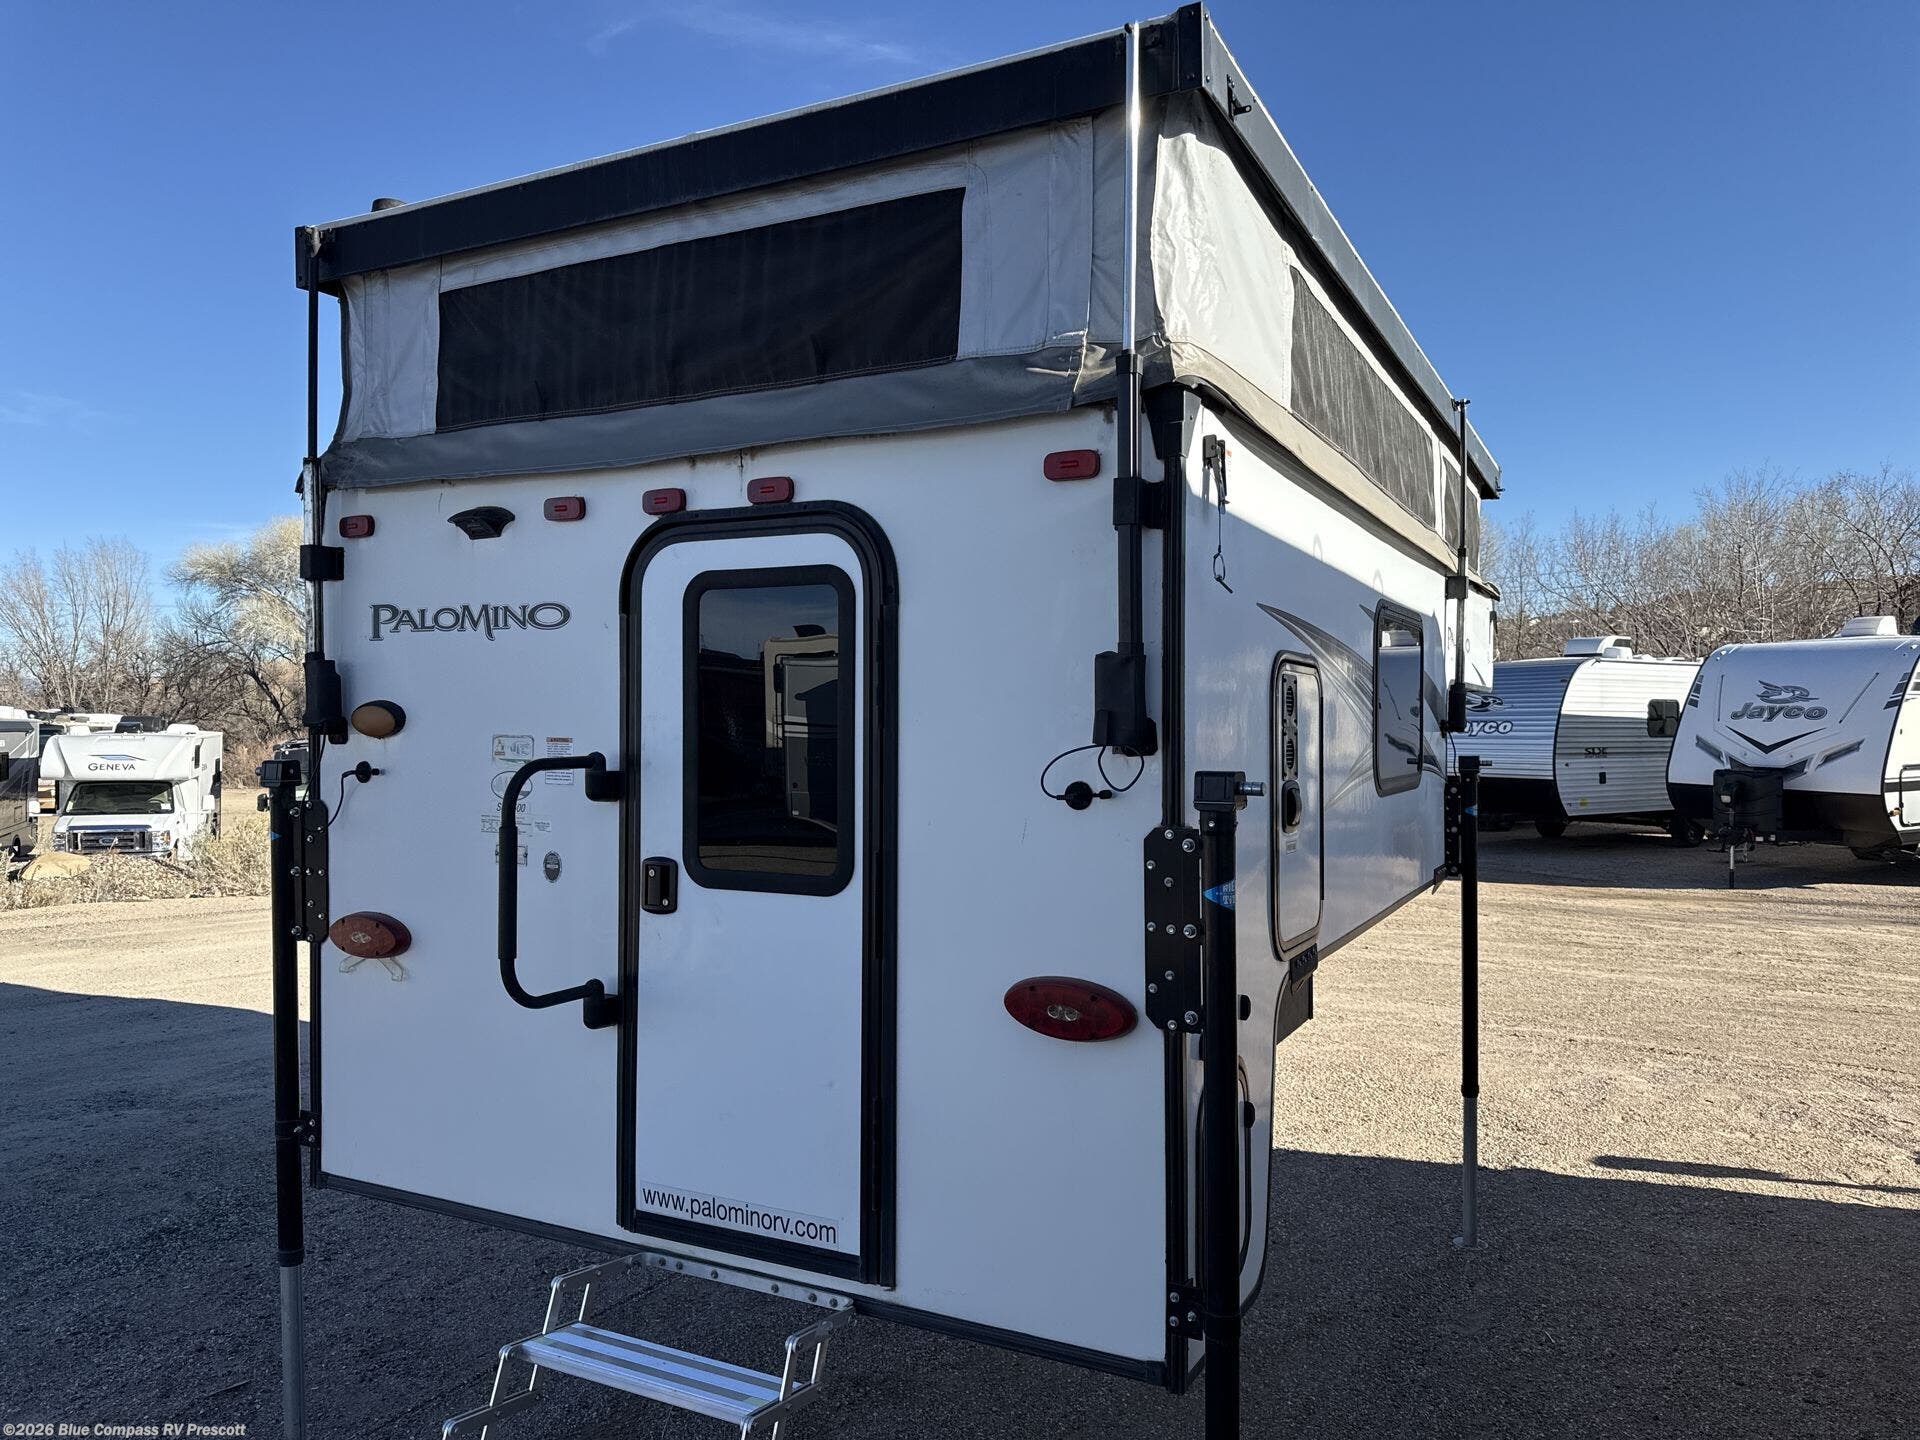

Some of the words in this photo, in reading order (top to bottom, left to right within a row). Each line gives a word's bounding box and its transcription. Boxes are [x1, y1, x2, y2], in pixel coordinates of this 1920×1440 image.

[369, 602, 571, 641] PALOMINO
[1731, 702, 1828, 722] Jayco
[1464, 720, 1513, 737] yco
[88, 762, 136, 771] GENEVA
[642, 1188, 837, 1244] www.palominorv.com
